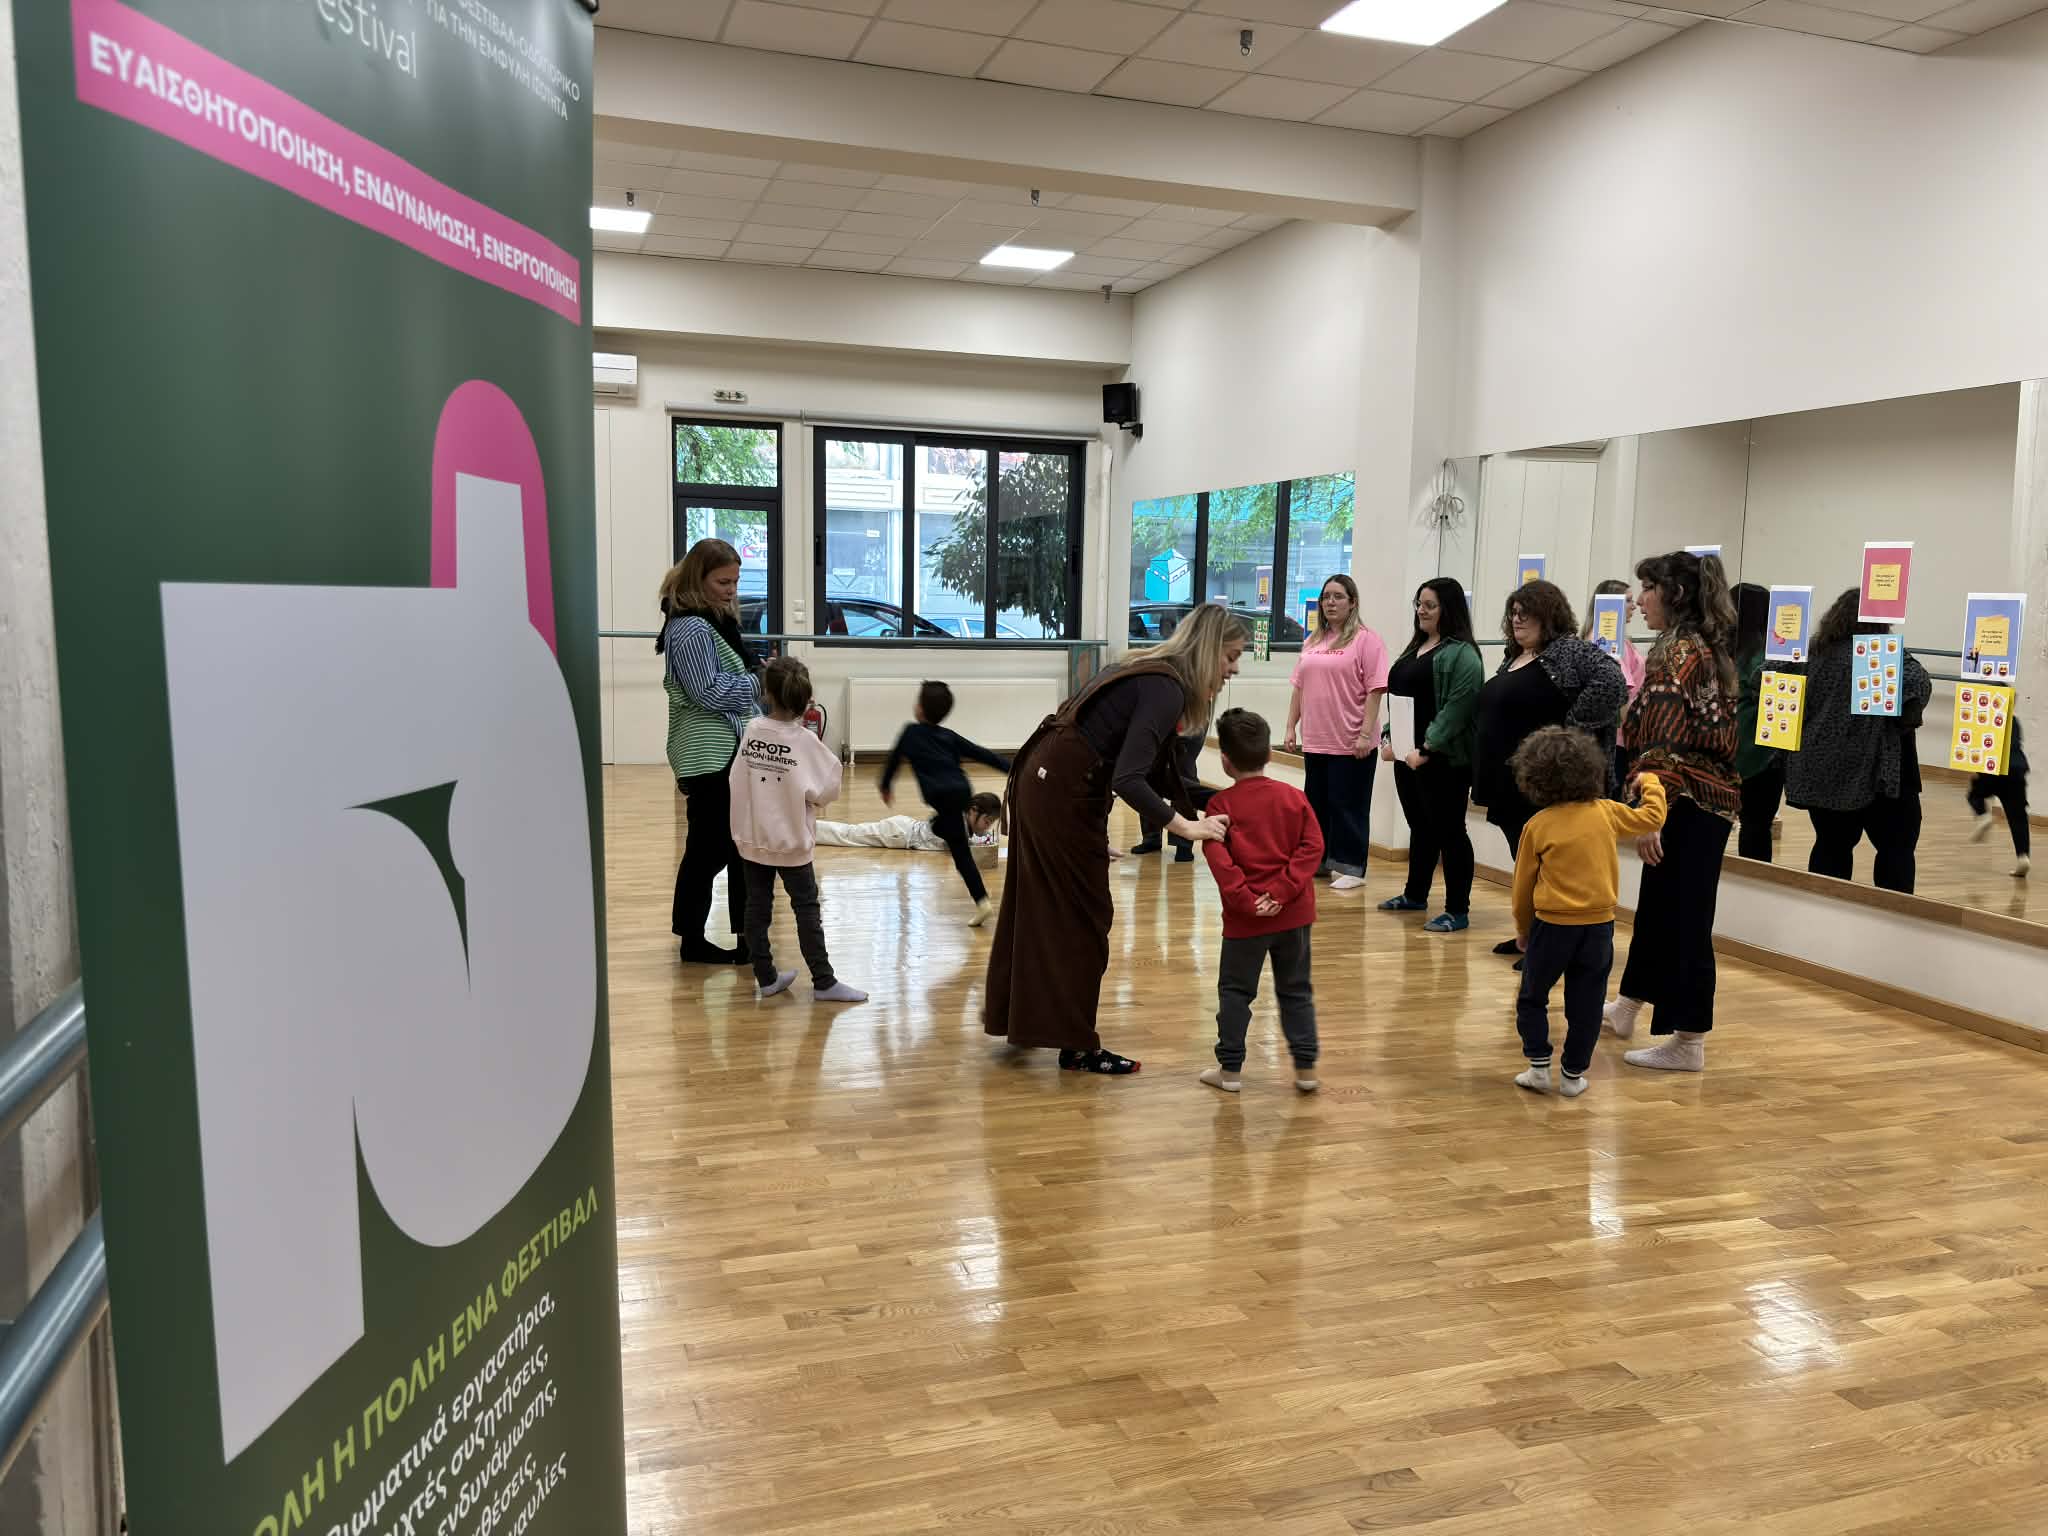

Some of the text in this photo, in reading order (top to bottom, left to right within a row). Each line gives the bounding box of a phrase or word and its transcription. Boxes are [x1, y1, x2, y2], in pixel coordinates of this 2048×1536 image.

[88, 31, 578, 304] ΕΥΑΙΣΘΗΤΟΠΟΙΗΣΗ, ΕΝΔΥΝΑΜΩΣΗ, ΕΝΕΡΓΟΠΟΙΗΣΗ
[333, 1424, 355, 1484] Η
[363, 1334, 445, 1451] ΠΟΛΗ
[452, 1282, 498, 1358] ΕΝΑ
[501, 1185, 598, 1298] ΦΕΣΤΙΒΑΛ
[452, 1292, 555, 1422] εργαστήρια,
[384, 1344, 549, 1536] ιχτές συζητήσεις,
[438, 1379, 557, 1536] ενδυνάμωσης,
